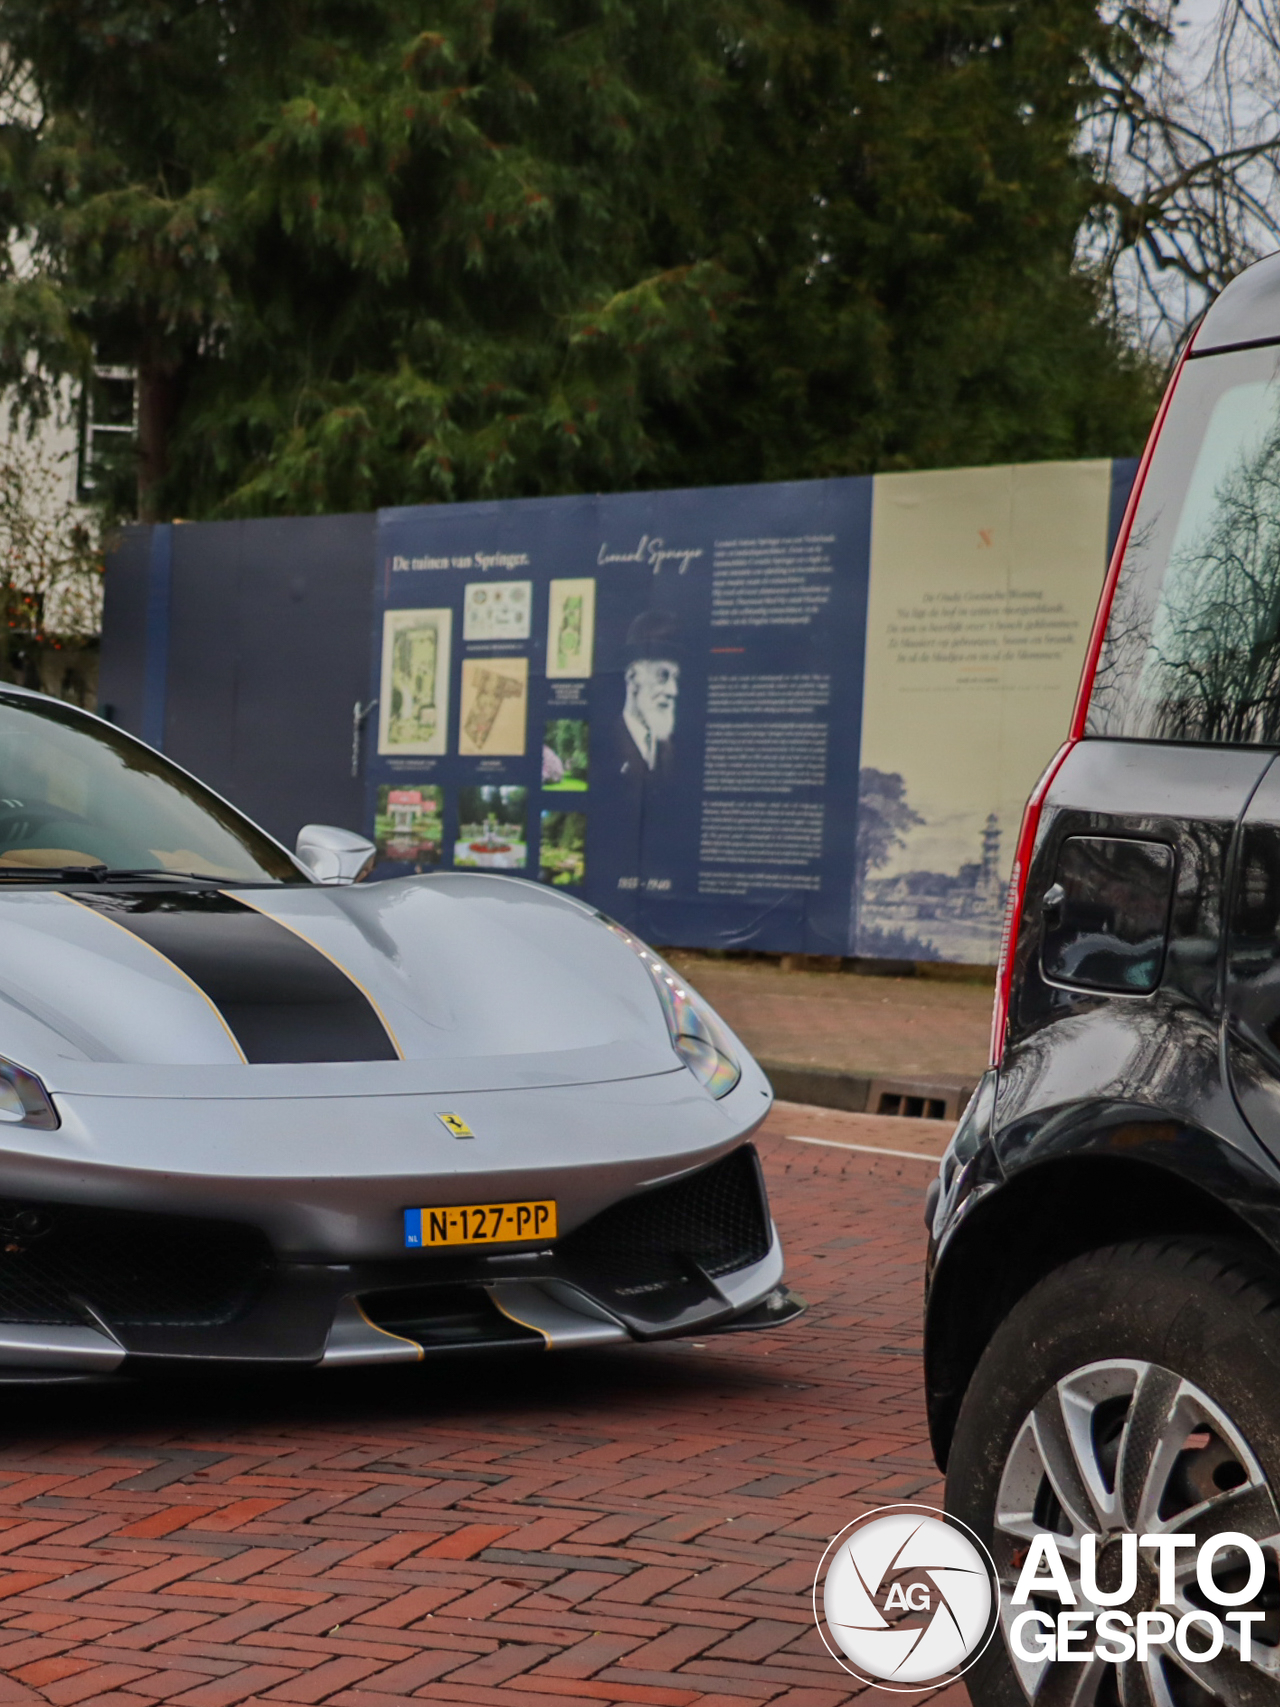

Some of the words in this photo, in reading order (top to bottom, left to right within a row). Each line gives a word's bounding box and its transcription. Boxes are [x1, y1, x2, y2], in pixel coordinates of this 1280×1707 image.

[393, 555, 410, 572] De
[411, 555, 450, 571] tuinen
[451, 556, 473, 569] van
[430, 1205, 549, 1241] N-127-PP
[408, 1235, 419, 1243] NL
